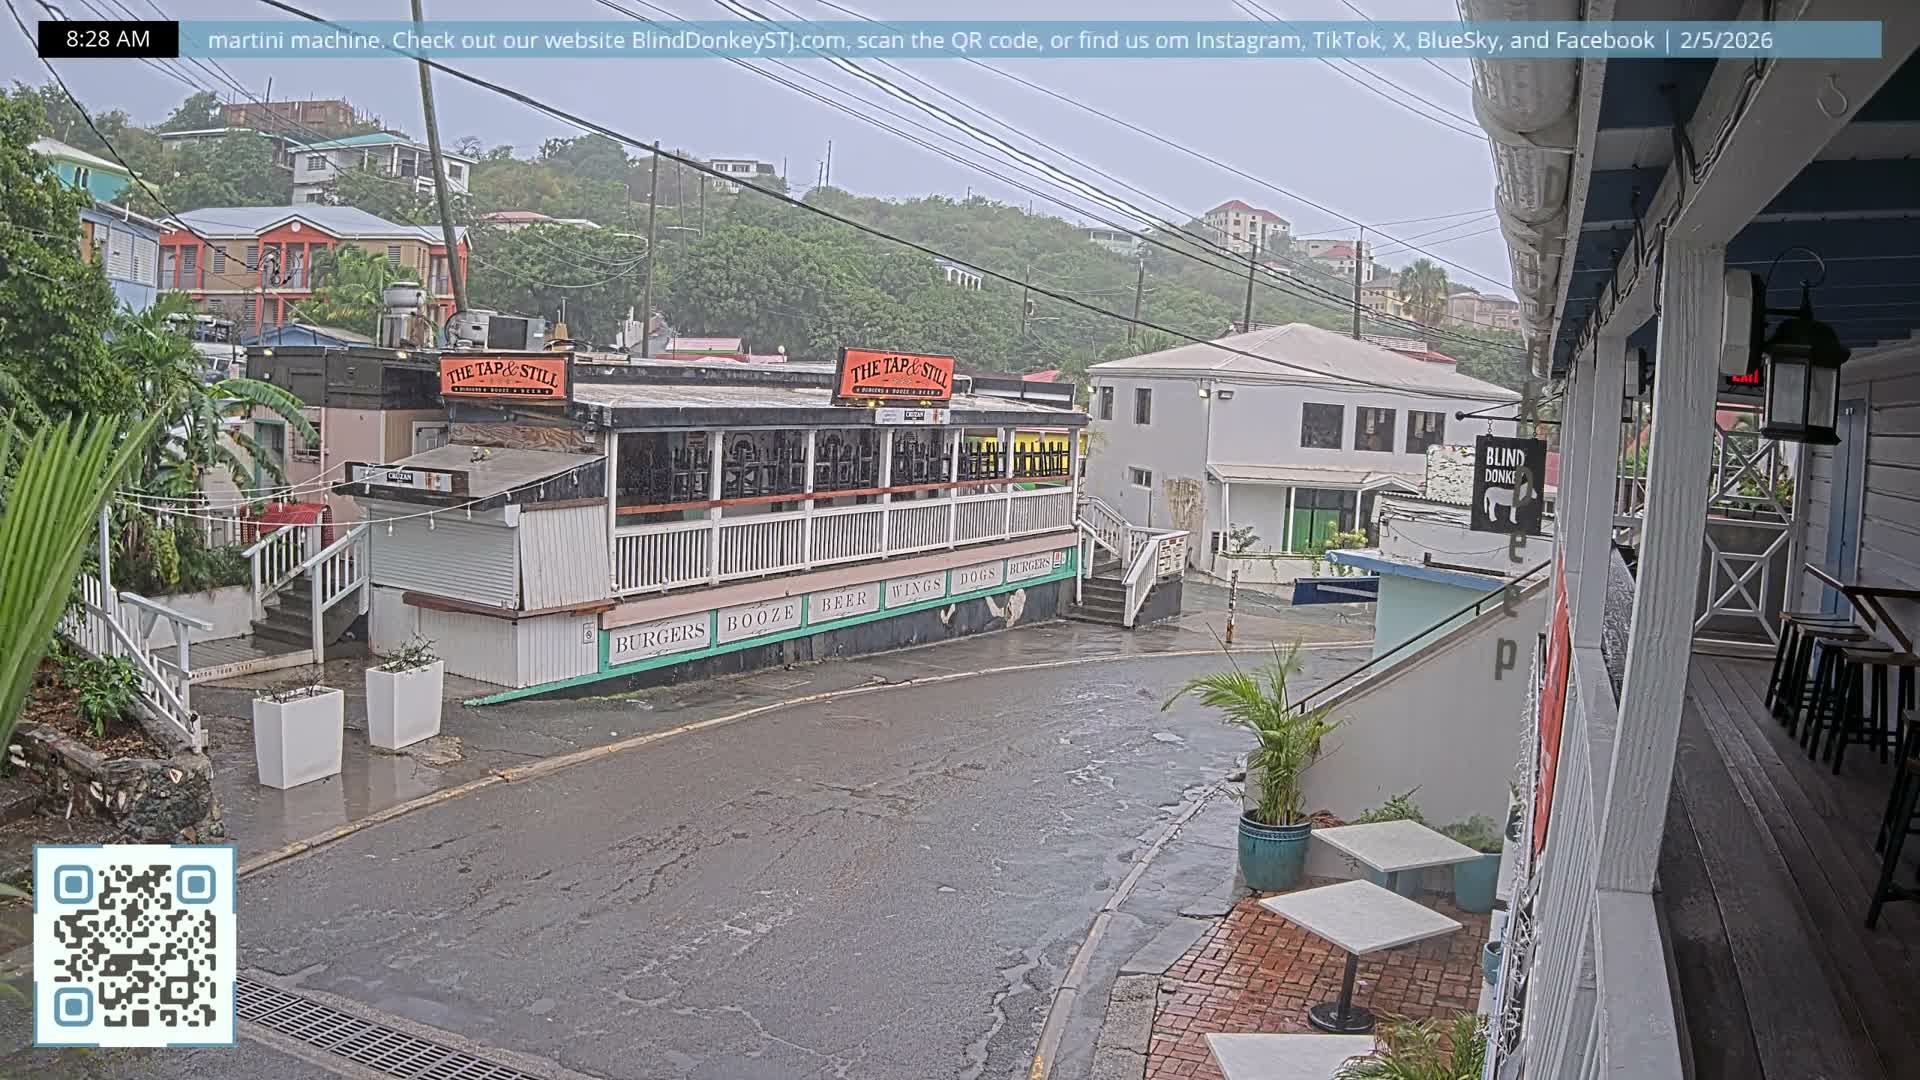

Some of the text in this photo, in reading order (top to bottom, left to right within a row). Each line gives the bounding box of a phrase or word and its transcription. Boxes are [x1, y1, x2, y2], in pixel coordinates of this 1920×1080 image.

[447, 360, 558, 388] THE TAP & STILL
[851, 357, 947, 388] THE TAP & STILL
[1486, 446, 1526, 467] BLIND
[1484, 468, 1526, 484] DONKE
[960, 567, 996, 585] DOGS
[1009, 557, 1050, 576] BURGERS
[892, 578, 942, 600] WINGS
[822, 591, 867, 612] BEER
[727, 604, 794, 633] BOOZE
[616, 622, 706, 654] BURGERS
